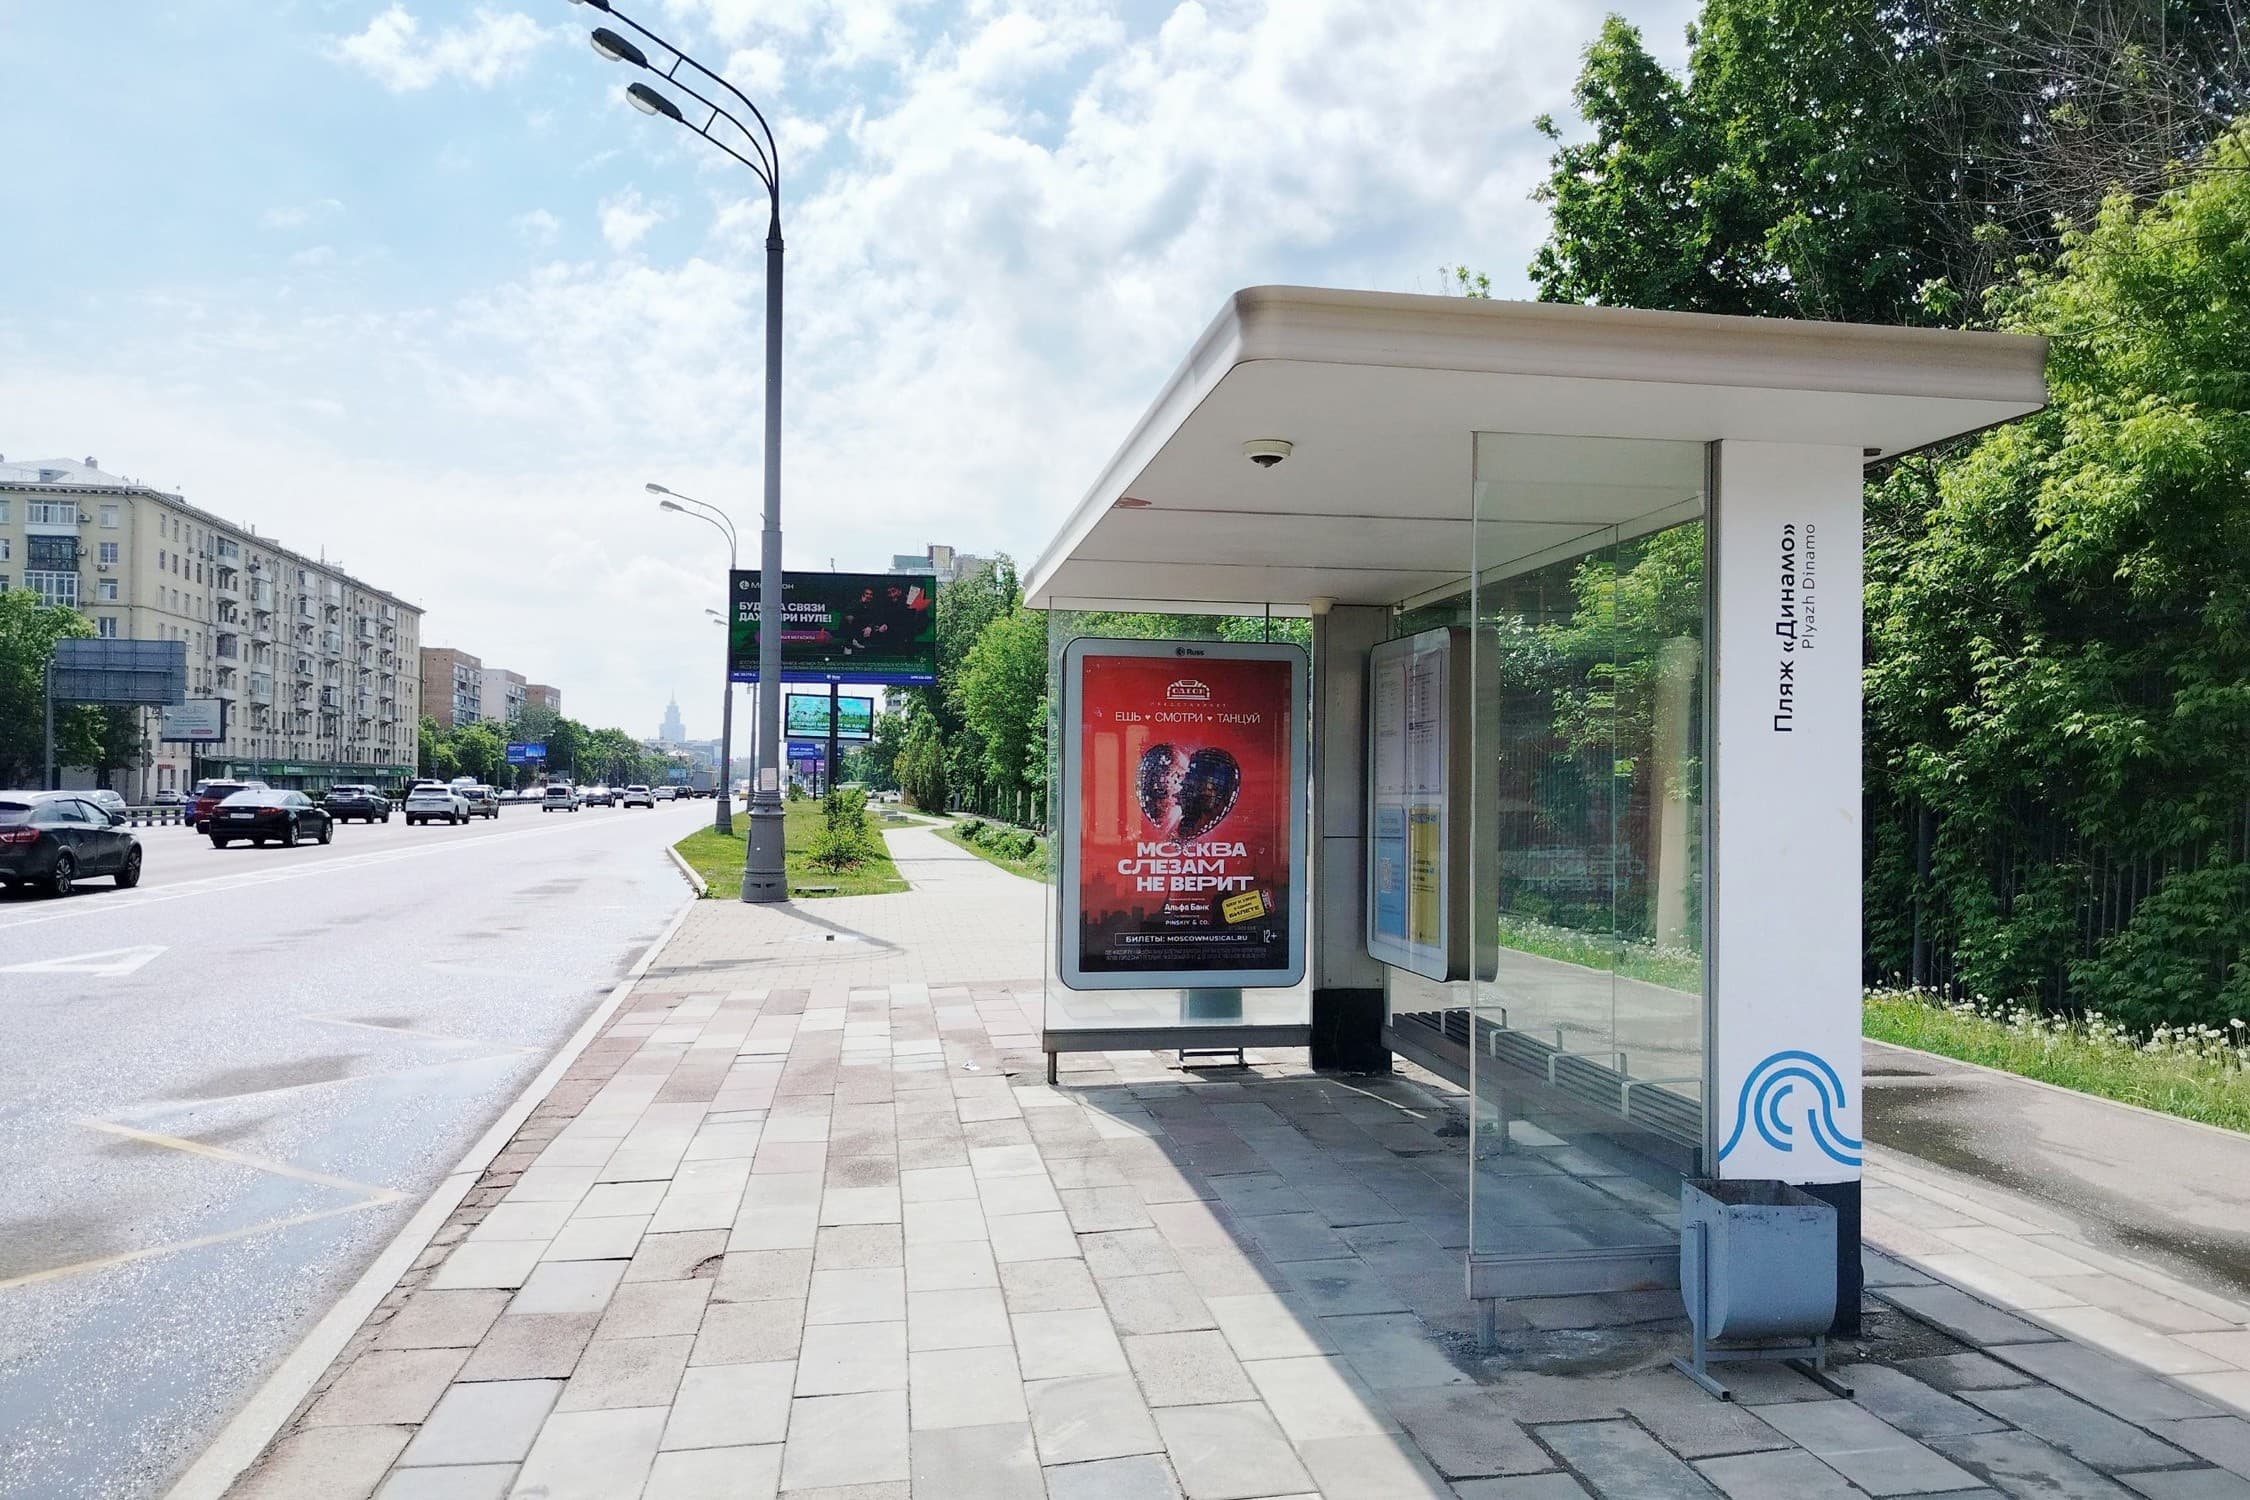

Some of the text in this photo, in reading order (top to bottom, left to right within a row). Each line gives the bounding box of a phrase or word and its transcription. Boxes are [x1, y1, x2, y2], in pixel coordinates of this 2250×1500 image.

[1802, 524, 1817, 649] Plyazh Dinamo
[739, 602, 761, 612] БУД
[788, 603, 826, 613] СВЯЗИ
[739, 612, 832, 623] ДАЖ РИ НУЛЕ!
[1774, 524, 1798, 731] Пляж «Динамо»
[1115, 711, 1260, 725] ЕШЬ СМОТРИ ТАНЦУЙ
[1136, 841, 1247, 858] МОСКВА
[1118, 859, 1225, 875] СЛЕЗАМ
[1136, 876, 1254, 892] НЕ ВЕРИТ
[1164, 903, 1210, 913] Альфа Банк
[1125, 935, 1248, 943] БИЛЕТЫ: MOSCOWMUSICAL.RU
[1263, 929, 1278, 944] 12+
